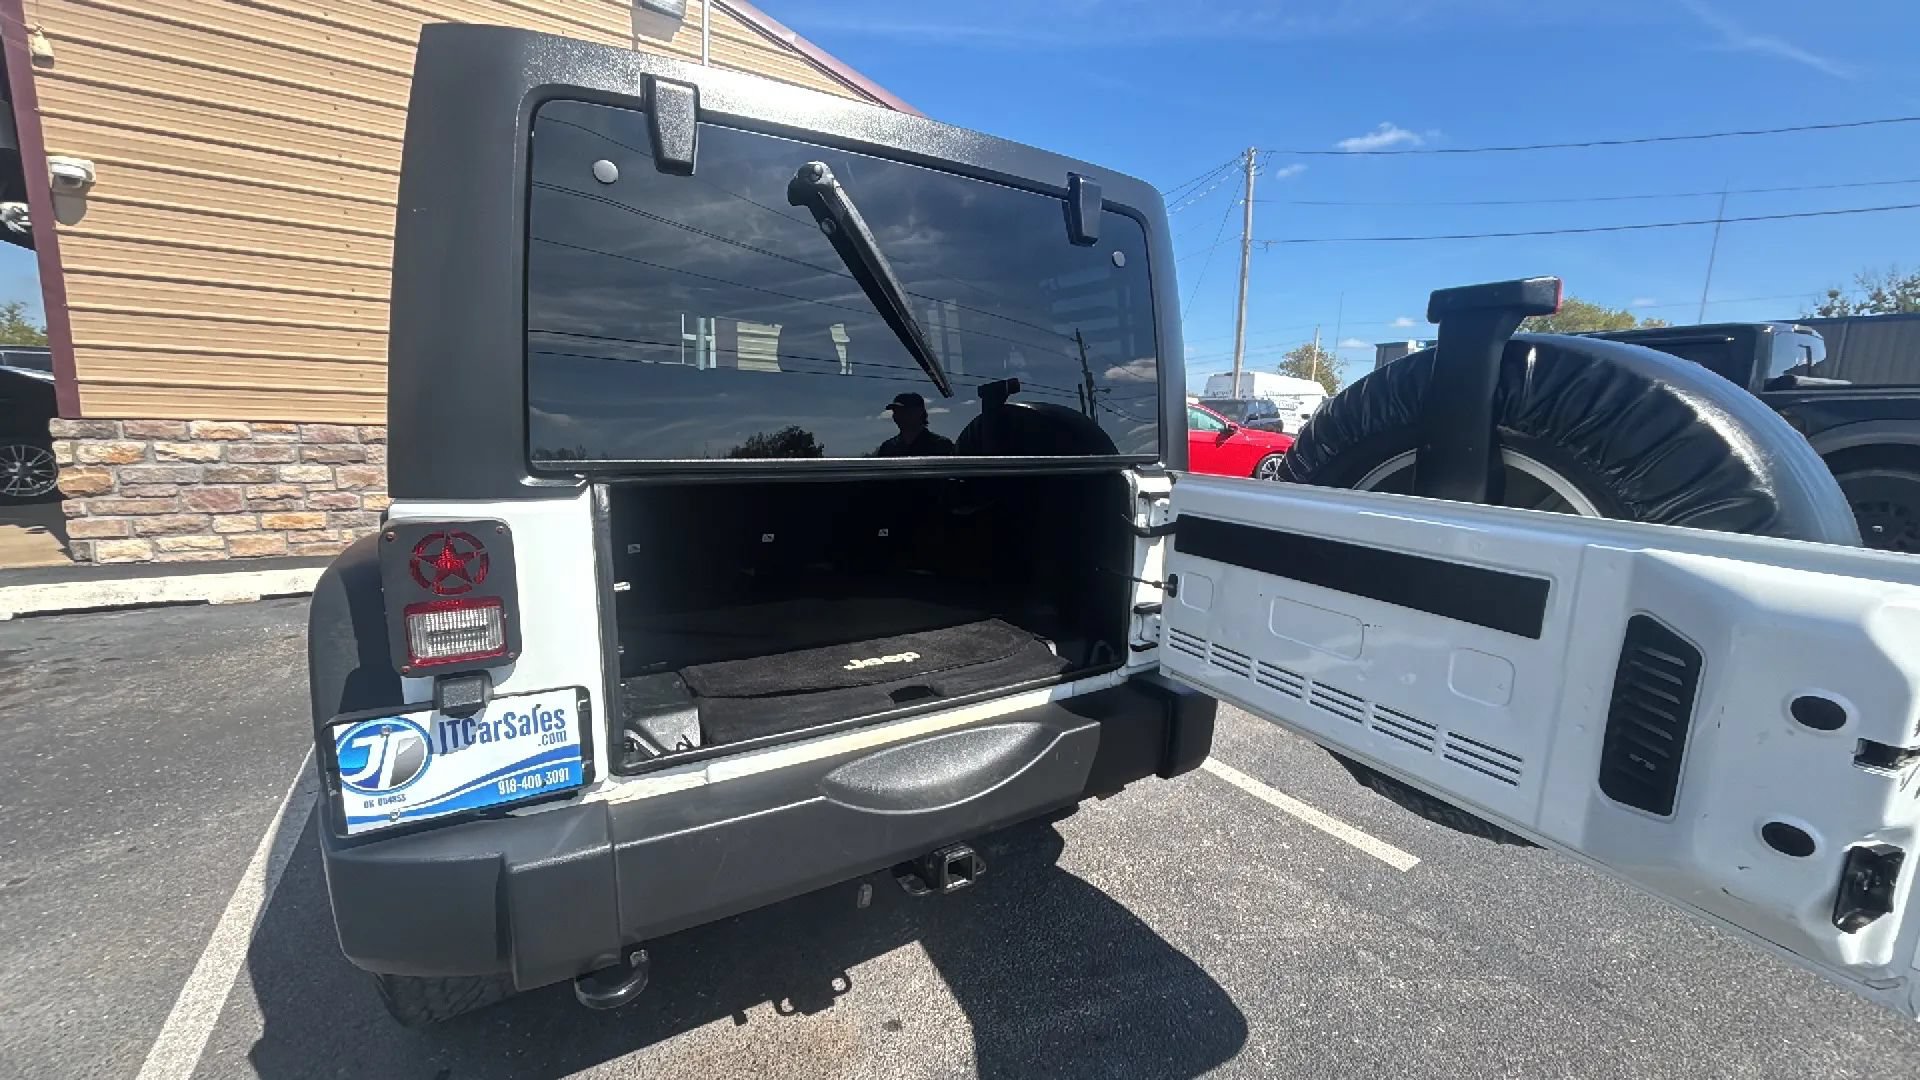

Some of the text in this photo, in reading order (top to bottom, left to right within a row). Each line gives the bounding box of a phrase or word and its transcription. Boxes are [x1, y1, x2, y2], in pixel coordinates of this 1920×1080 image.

[843, 651, 921, 670] Jeep
[438, 706, 566, 756] JTCarSales
[538, 730, 568, 747] .com
